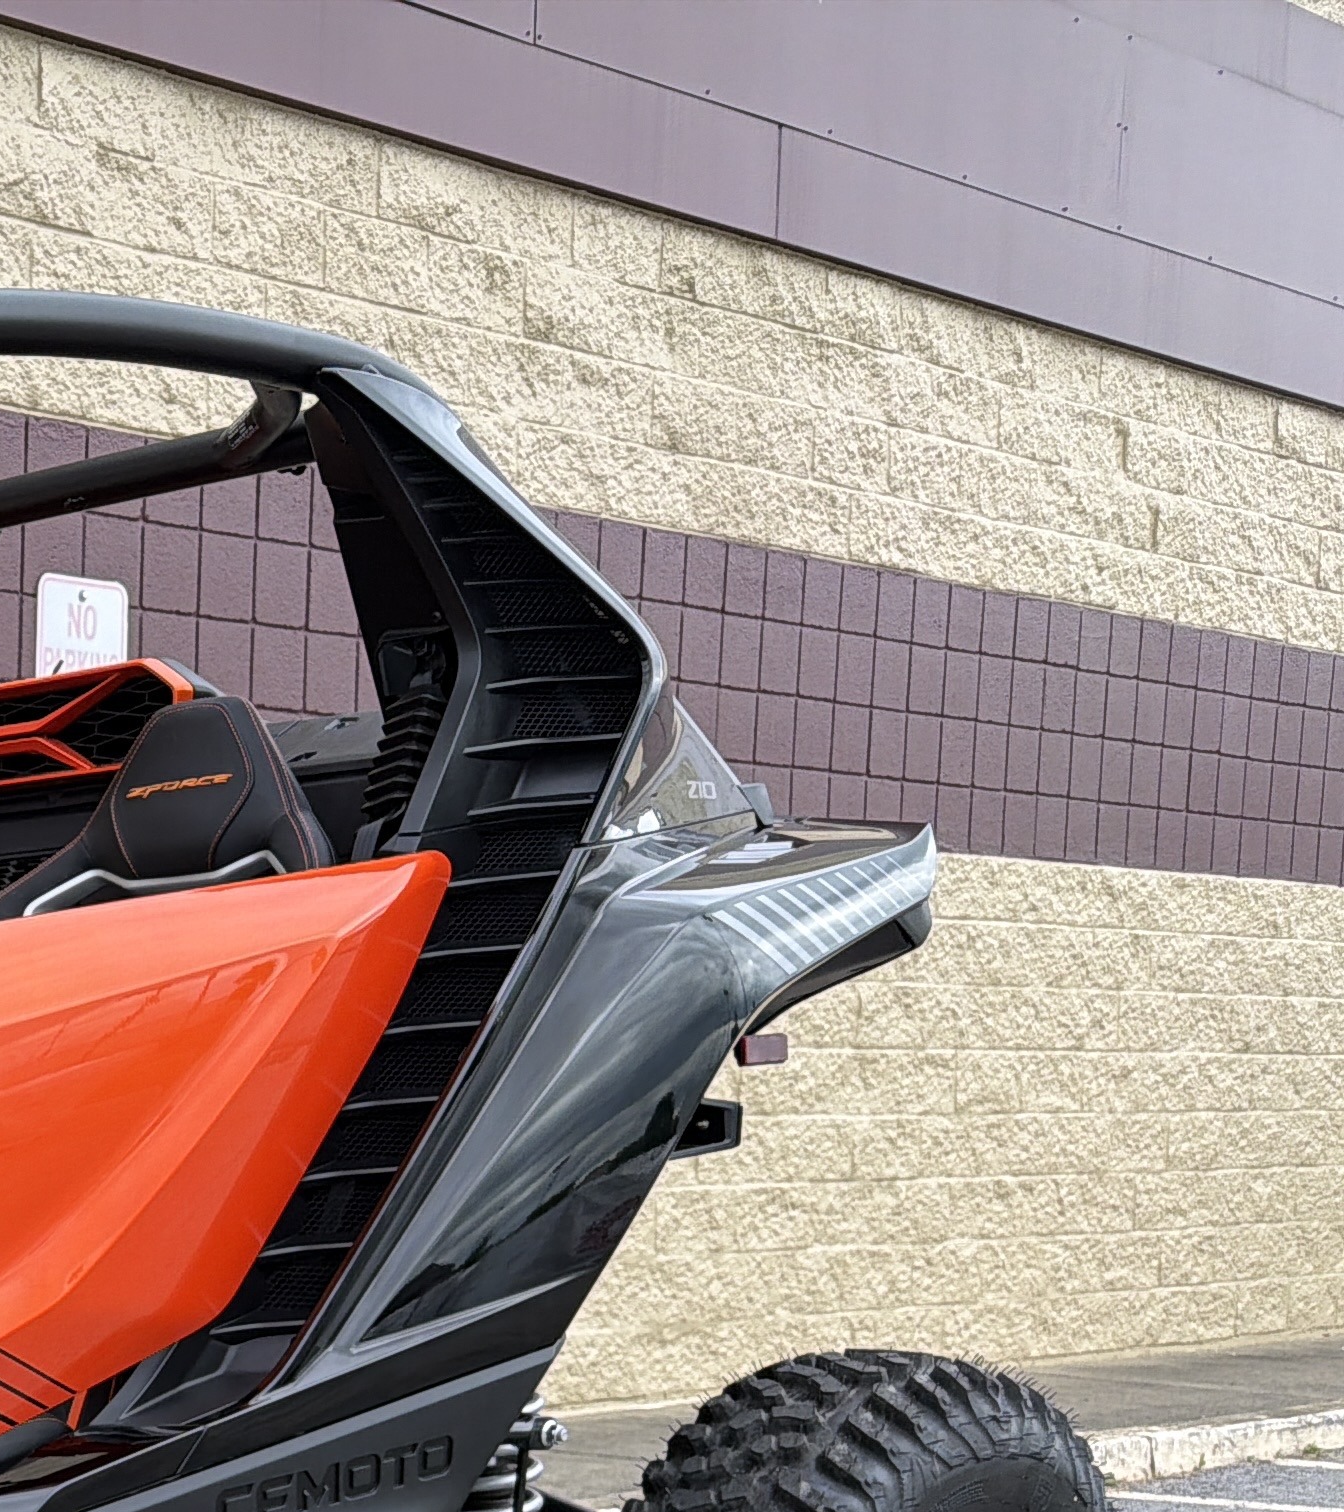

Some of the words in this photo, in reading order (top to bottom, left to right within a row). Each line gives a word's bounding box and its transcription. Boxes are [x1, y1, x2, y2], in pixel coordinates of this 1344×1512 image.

[67, 603, 97, 640] NO
[43, 647, 118, 672] PRKI
[126, 773, 234, 799] ZFORCE
[686, 780, 717, 799] Z10
